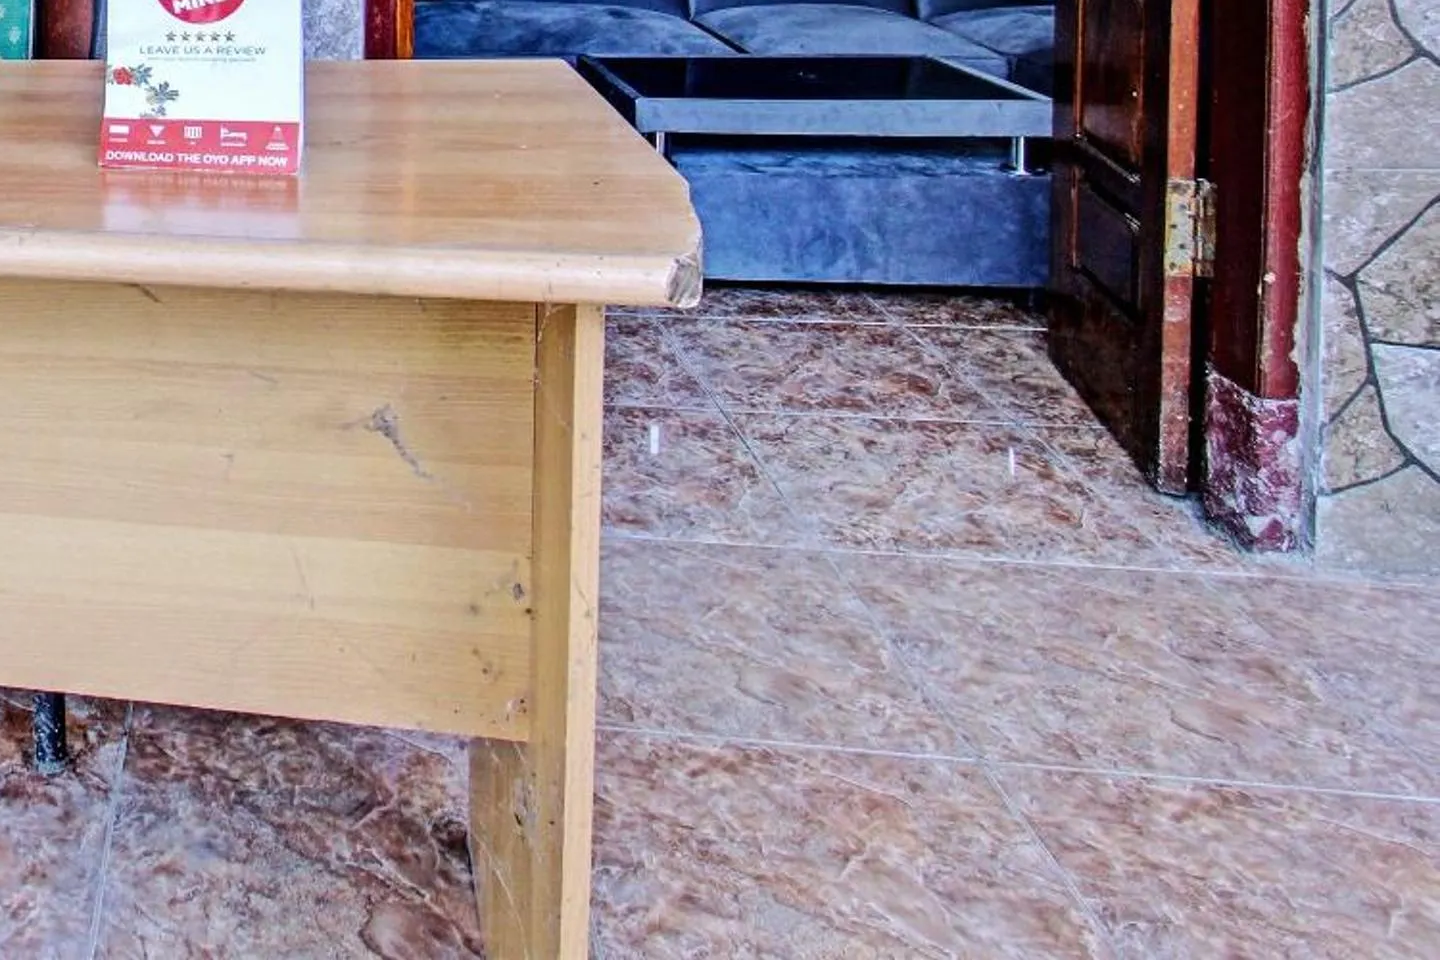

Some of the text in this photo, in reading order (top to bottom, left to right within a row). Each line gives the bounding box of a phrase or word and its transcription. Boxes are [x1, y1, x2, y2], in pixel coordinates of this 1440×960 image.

[139, 45, 266, 56] LEAVE US A REVIEW
[105, 150, 288, 167] DOWNLOAD THE OYO APP NOW
